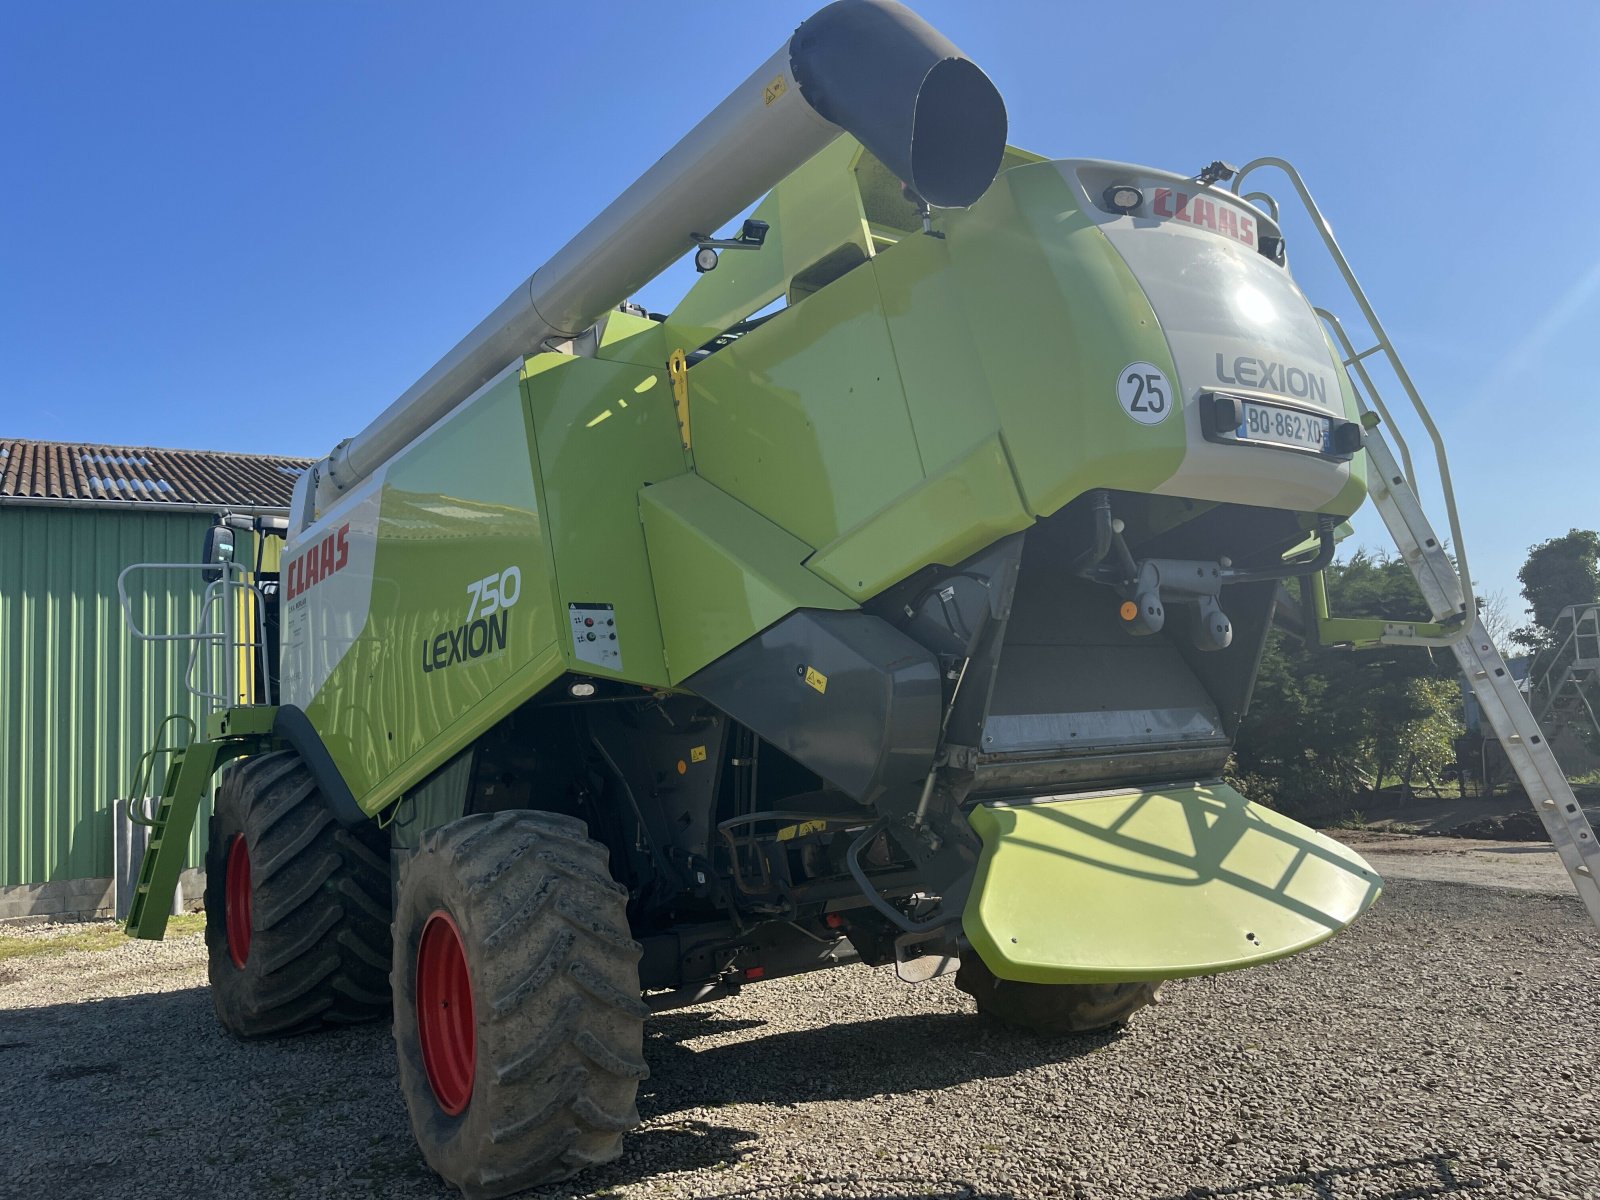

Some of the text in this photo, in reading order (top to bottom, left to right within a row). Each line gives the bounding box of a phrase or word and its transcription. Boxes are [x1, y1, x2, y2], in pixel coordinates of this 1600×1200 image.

[1153, 187, 1254, 247] CLAAS
[1126, 373, 1165, 414] 25
[1215, 352, 1328, 404] LEXION
[286, 522, 350, 601] CLAAS
[465, 565, 521, 623] 750
[422, 609, 508, 673] LEXION
